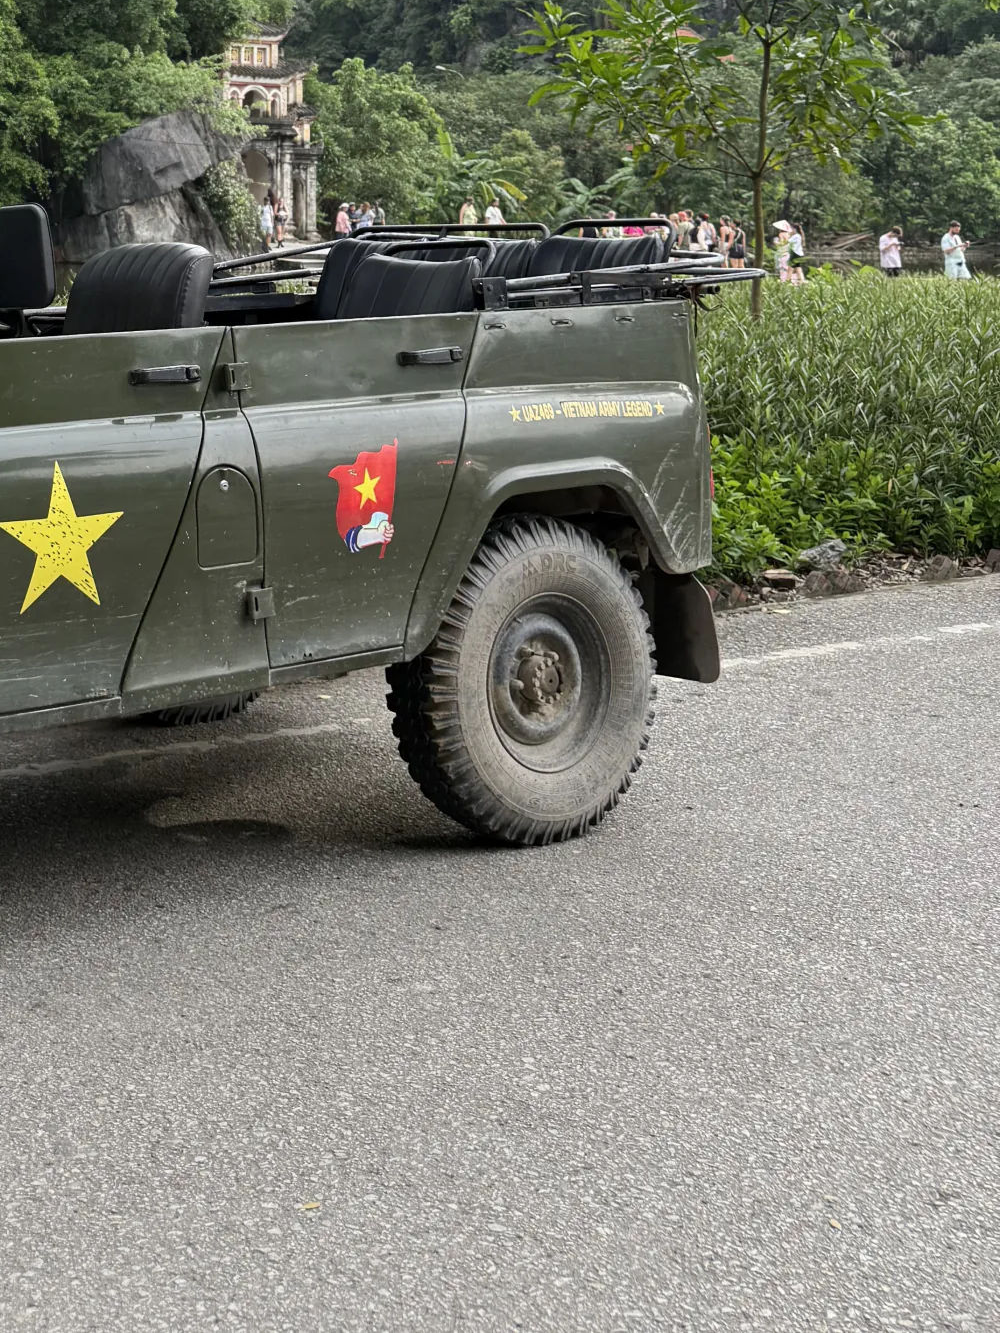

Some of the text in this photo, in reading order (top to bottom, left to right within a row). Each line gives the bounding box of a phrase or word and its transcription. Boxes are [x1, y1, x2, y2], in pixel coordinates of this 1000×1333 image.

[521, 402, 555, 422] UAZ469
[561, 401, 597, 418] VIETNAM
[598, 400, 620, 417] ARMY
[621, 400, 653, 417] LEGEND
[540, 552, 577, 573] DRC
